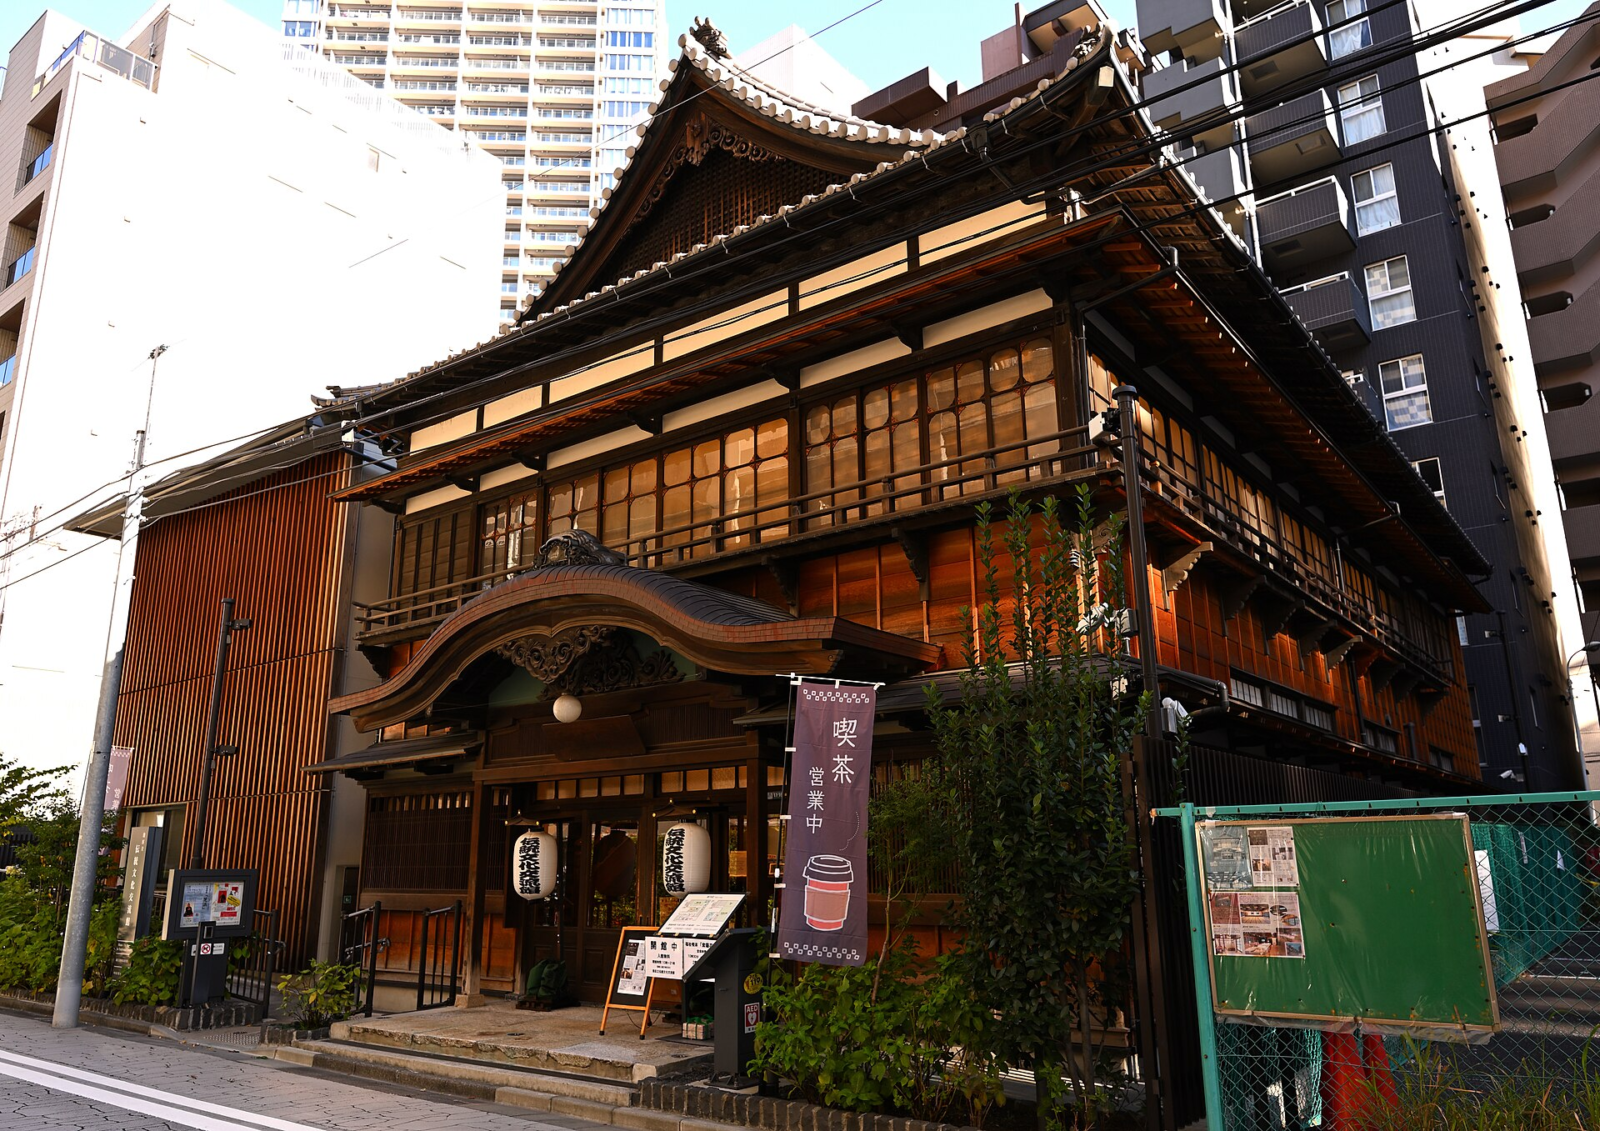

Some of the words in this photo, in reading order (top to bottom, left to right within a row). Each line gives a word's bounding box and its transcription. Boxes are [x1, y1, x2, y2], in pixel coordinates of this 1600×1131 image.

[831, 718, 857, 784] 喫茶
[806, 766, 825, 834] 営業中
[746, 1004, 758, 1013] AED
